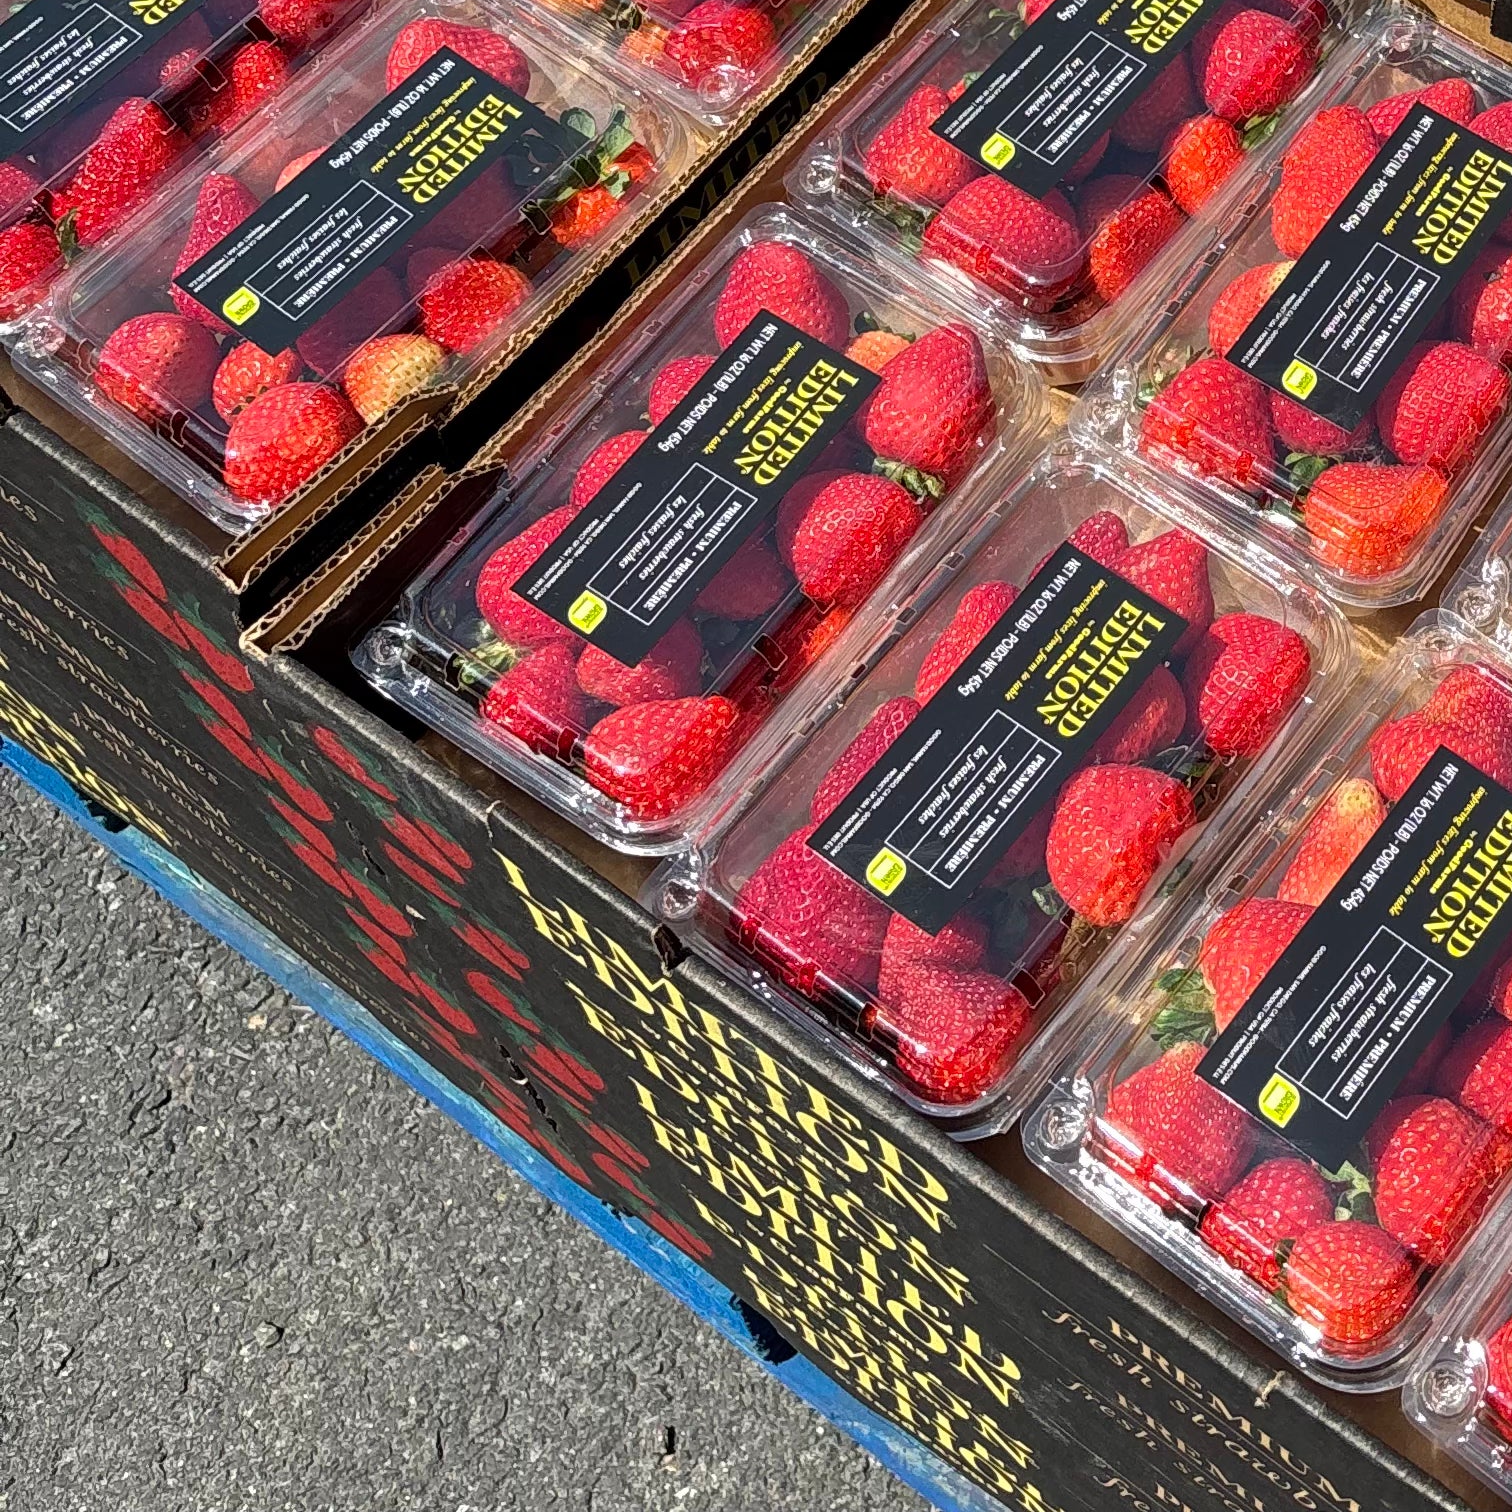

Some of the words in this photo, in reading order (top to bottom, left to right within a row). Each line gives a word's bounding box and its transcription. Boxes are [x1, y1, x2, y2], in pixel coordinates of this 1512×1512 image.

[412, 104, 524, 202] LIMITED
[624, 71, 827, 285] LIMITED
[753, 369, 859, 484] LIMITED
[0, 556, 129, 661] awberries
[0, 610, 48, 655] resh
[57, 656, 220, 786] strawberries
[1057, 612, 1166, 737] LIMITED
[997, 753, 1046, 808] PREMIUM
[492, 847, 949, 1202] LIMITED
[1330, 1003, 1376, 1063] strawberries
[1373, 974, 1396, 1005] fresh
[667, 1039, 851, 1182] GoodFarms
[1041, 1309, 1153, 1388] fresh
[1107, 1316, 1362, 1512] PREMIUM
